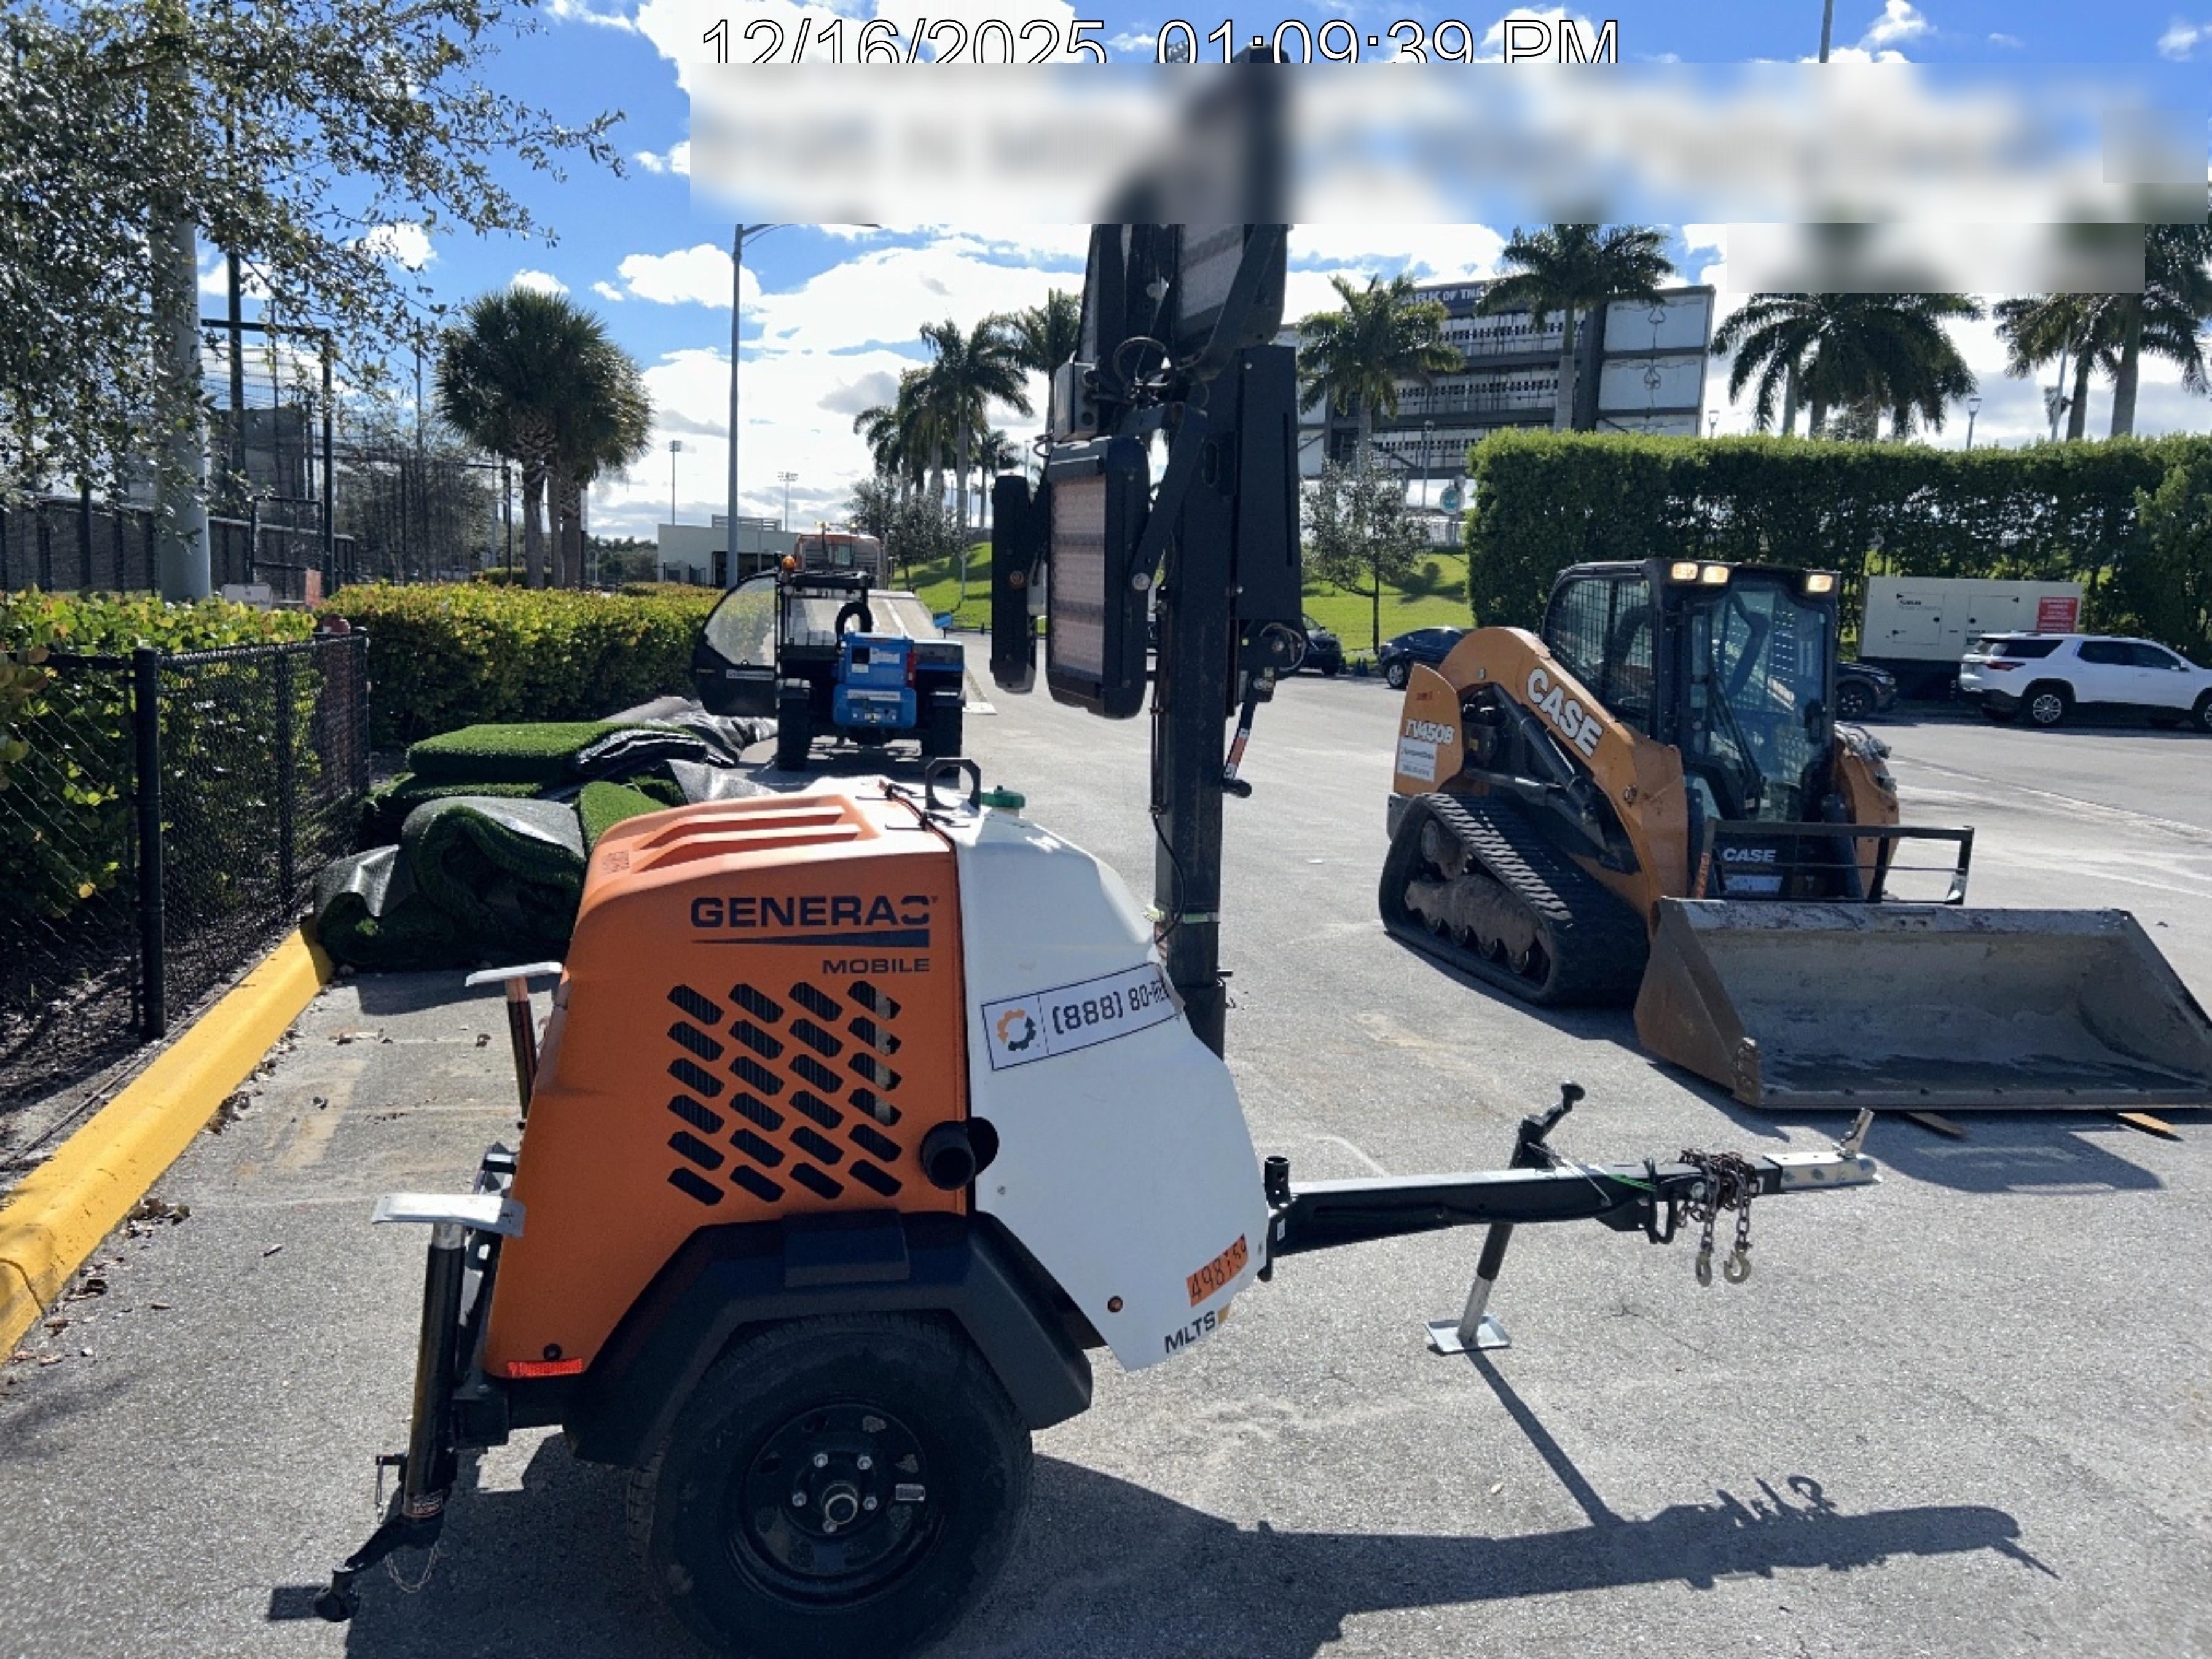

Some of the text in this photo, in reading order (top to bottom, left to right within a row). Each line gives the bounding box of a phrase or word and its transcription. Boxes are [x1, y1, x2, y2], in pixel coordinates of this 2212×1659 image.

[1401, 291, 1441, 306] ARK
[1442, 290, 1459, 302] OF
[1527, 667, 1605, 760] CASE
[1722, 847, 1778, 863] CASE
[691, 895, 930, 928] GENERAC
[822, 957, 930, 974] MOBILE
[1052, 990, 1124, 1035] (888)
[1164, 1309, 1216, 1354] MLTS
